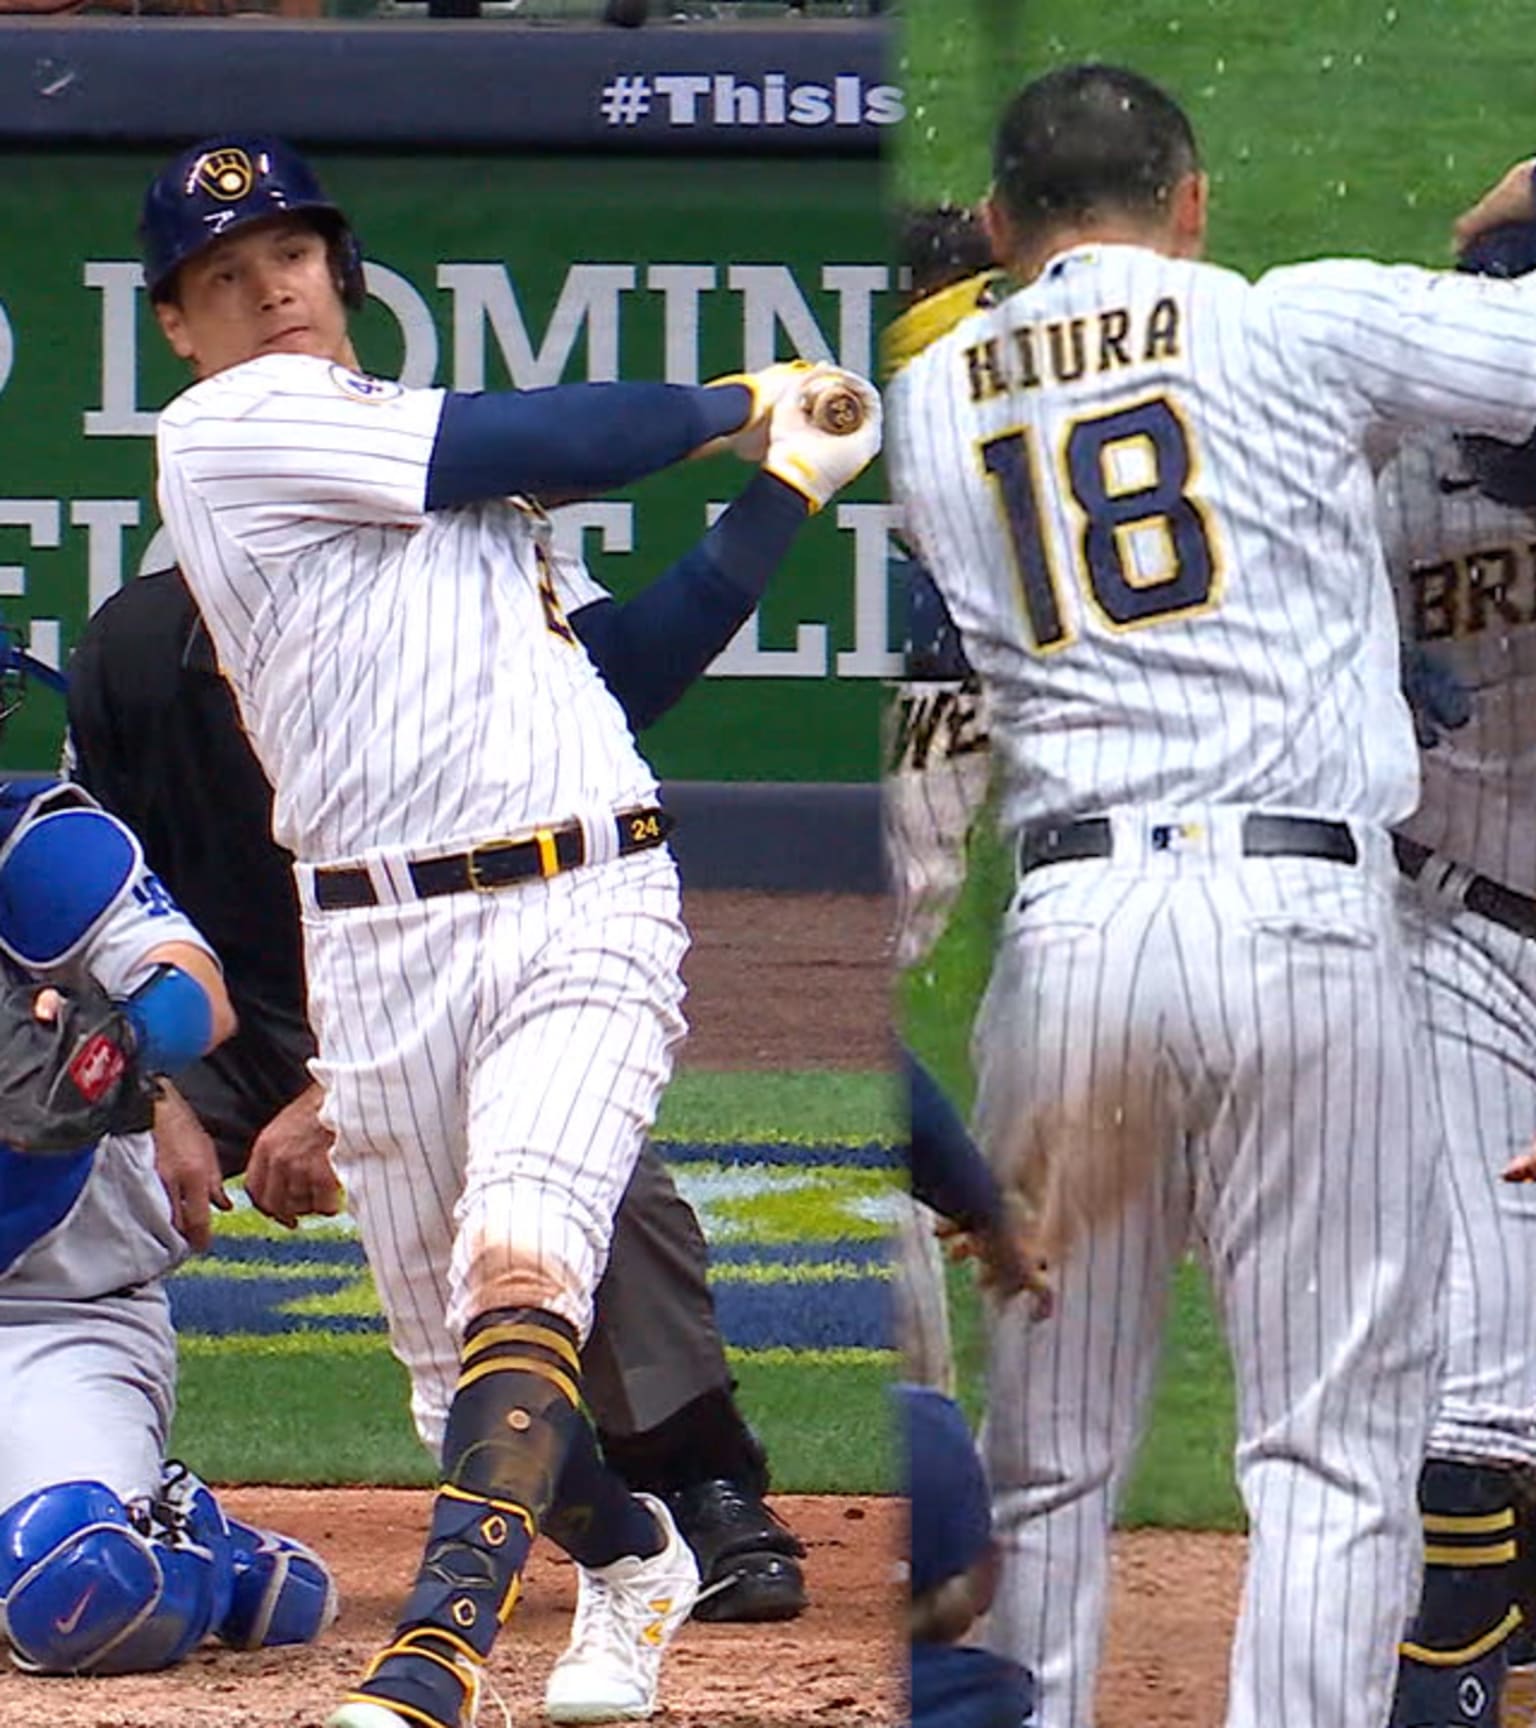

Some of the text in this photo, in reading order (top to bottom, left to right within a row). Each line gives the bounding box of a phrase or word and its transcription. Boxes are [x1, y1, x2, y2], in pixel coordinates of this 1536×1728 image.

[600, 75, 906, 124] #ThisIs
[962, 295, 1182, 402] HIURA
[974, 393, 1224, 660] 18
[630, 815, 660, 841] 24
